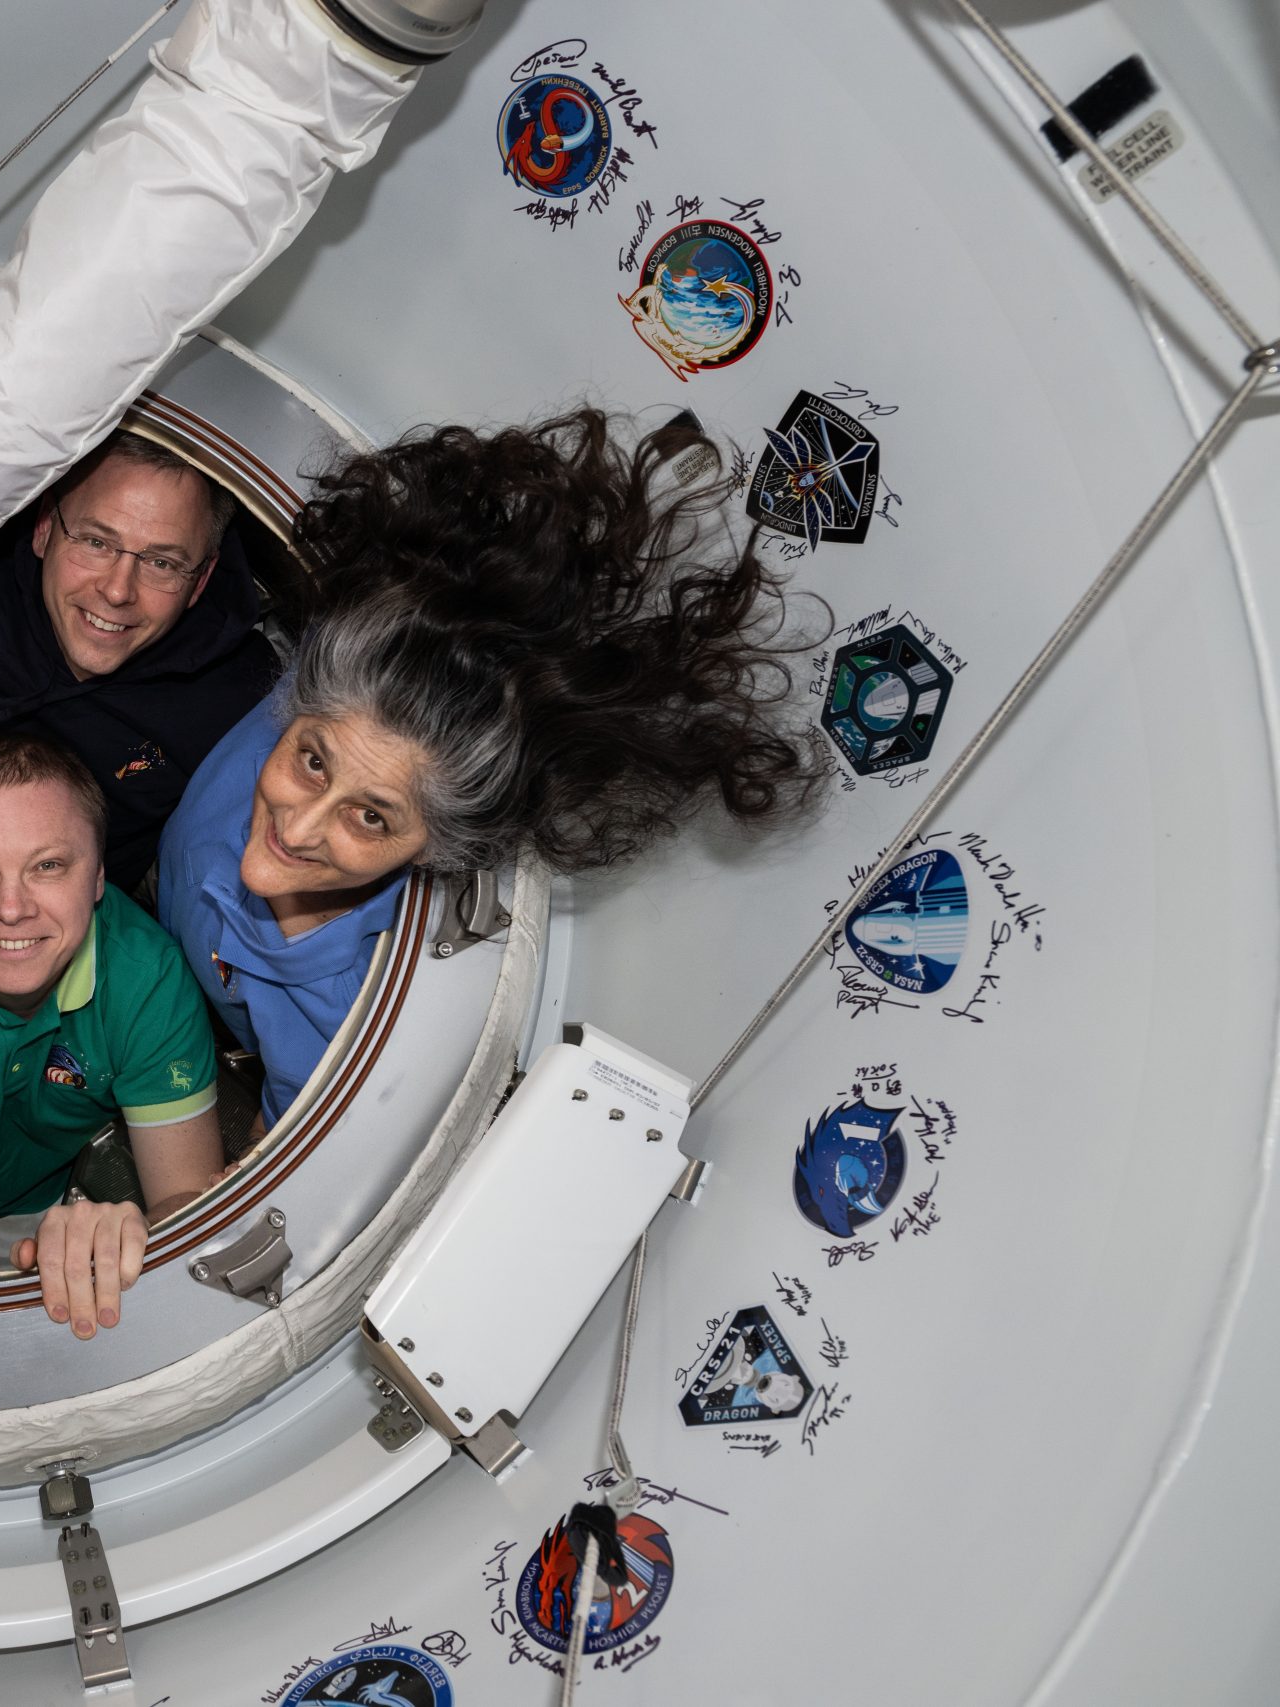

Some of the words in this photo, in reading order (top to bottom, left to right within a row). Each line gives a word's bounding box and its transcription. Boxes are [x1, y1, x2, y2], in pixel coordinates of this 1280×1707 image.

[591, 98, 610, 139] BARRATT
[1123, 121, 1158, 148] CELL
[1138, 125, 1171, 153] LINE
[584, 146, 609, 184] DOMINICK
[562, 183, 582, 195] EPPS
[646, 236, 677, 273] БОРИСОВ
[708, 225, 755, 259] MOGENSEN
[752, 261, 769, 317] MOGHBELI
[807, 396, 867, 439] CRISTOFORETTI
[753, 463, 768, 492] HINES
[861, 474, 877, 517] WATKINS
[857, 635, 883, 648] NASA
[829, 728, 857, 764] DRAGON
[872, 756, 911, 771] SPACEX
[857, 873, 891, 910] SPACEX
[892, 852, 938, 880] DRAGON
[856, 945, 885, 976] CRS-22
[894, 973, 924, 991] NASA
[760, 1320, 792, 1366] SPACEX
[703, 1407, 759, 1422] DRAGON
[519, 1561, 540, 1621] KIMBROUGH
[616, 1584, 649, 1607] 2
[641, 1572, 669, 1620] PESQUET
[588, 1621, 640, 1649] HOSHIDE
[288, 1665, 334, 1704] HOBURG
[409, 1653, 446, 1689] ФЕДЯЕВ
